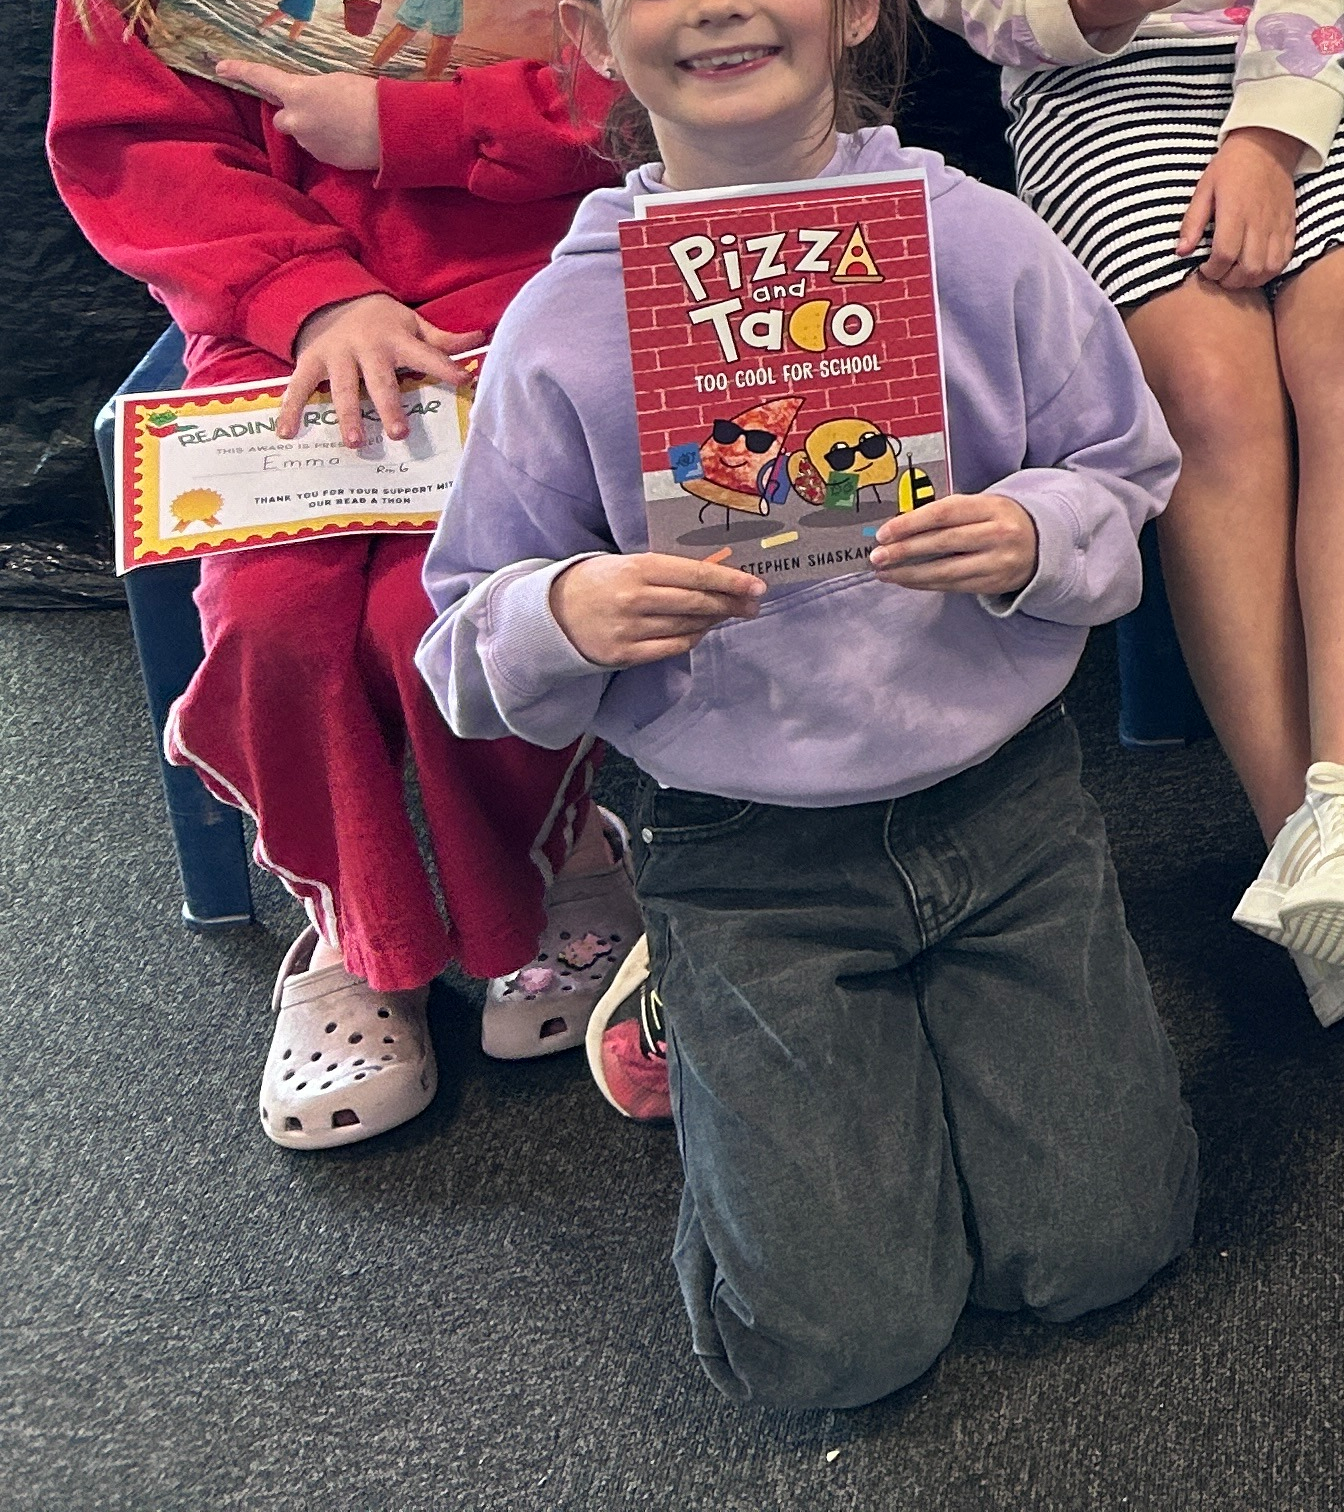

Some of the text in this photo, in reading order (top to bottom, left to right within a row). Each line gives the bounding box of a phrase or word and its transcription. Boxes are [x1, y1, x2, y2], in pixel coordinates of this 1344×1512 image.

[752, 277, 806, 304] and
[688, 298, 874, 363] Taco
[695, 353, 882, 394] TOO COOL FOR SCHOOL
[217, 447, 243, 455] THIS
[248, 443, 293, 452] AWARD
[263, 453, 340, 471] Emma
[254, 480, 454, 505] THANK YOU FOR YOUR SUPPORT WIT
[309, 499, 332, 508] OUR
[335, 497, 366, 505] READ
[808, 546, 873, 567] SHASKAN
